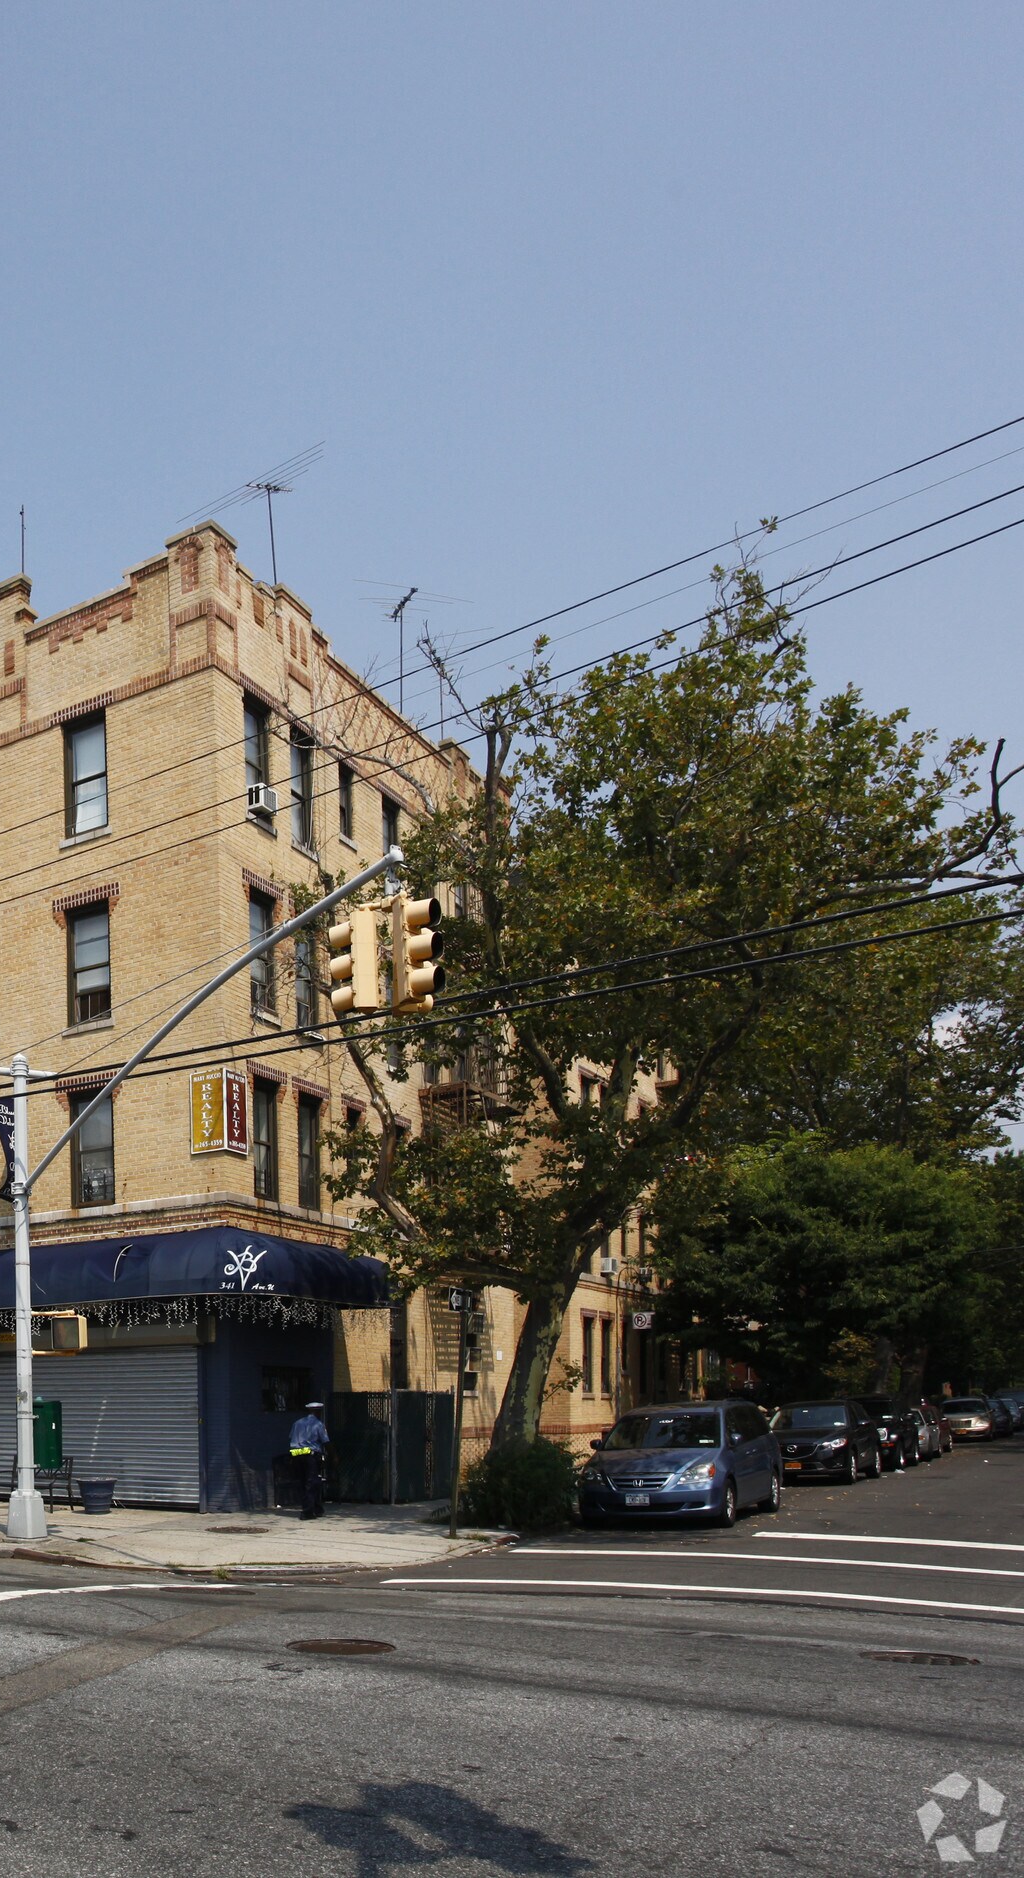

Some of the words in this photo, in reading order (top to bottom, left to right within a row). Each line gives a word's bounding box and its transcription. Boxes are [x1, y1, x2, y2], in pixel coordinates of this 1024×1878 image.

[201, 1083, 213, 1137] REALTY
[232, 1082, 241, 1138] REALTY
[219, 1282, 235, 1290] 341
